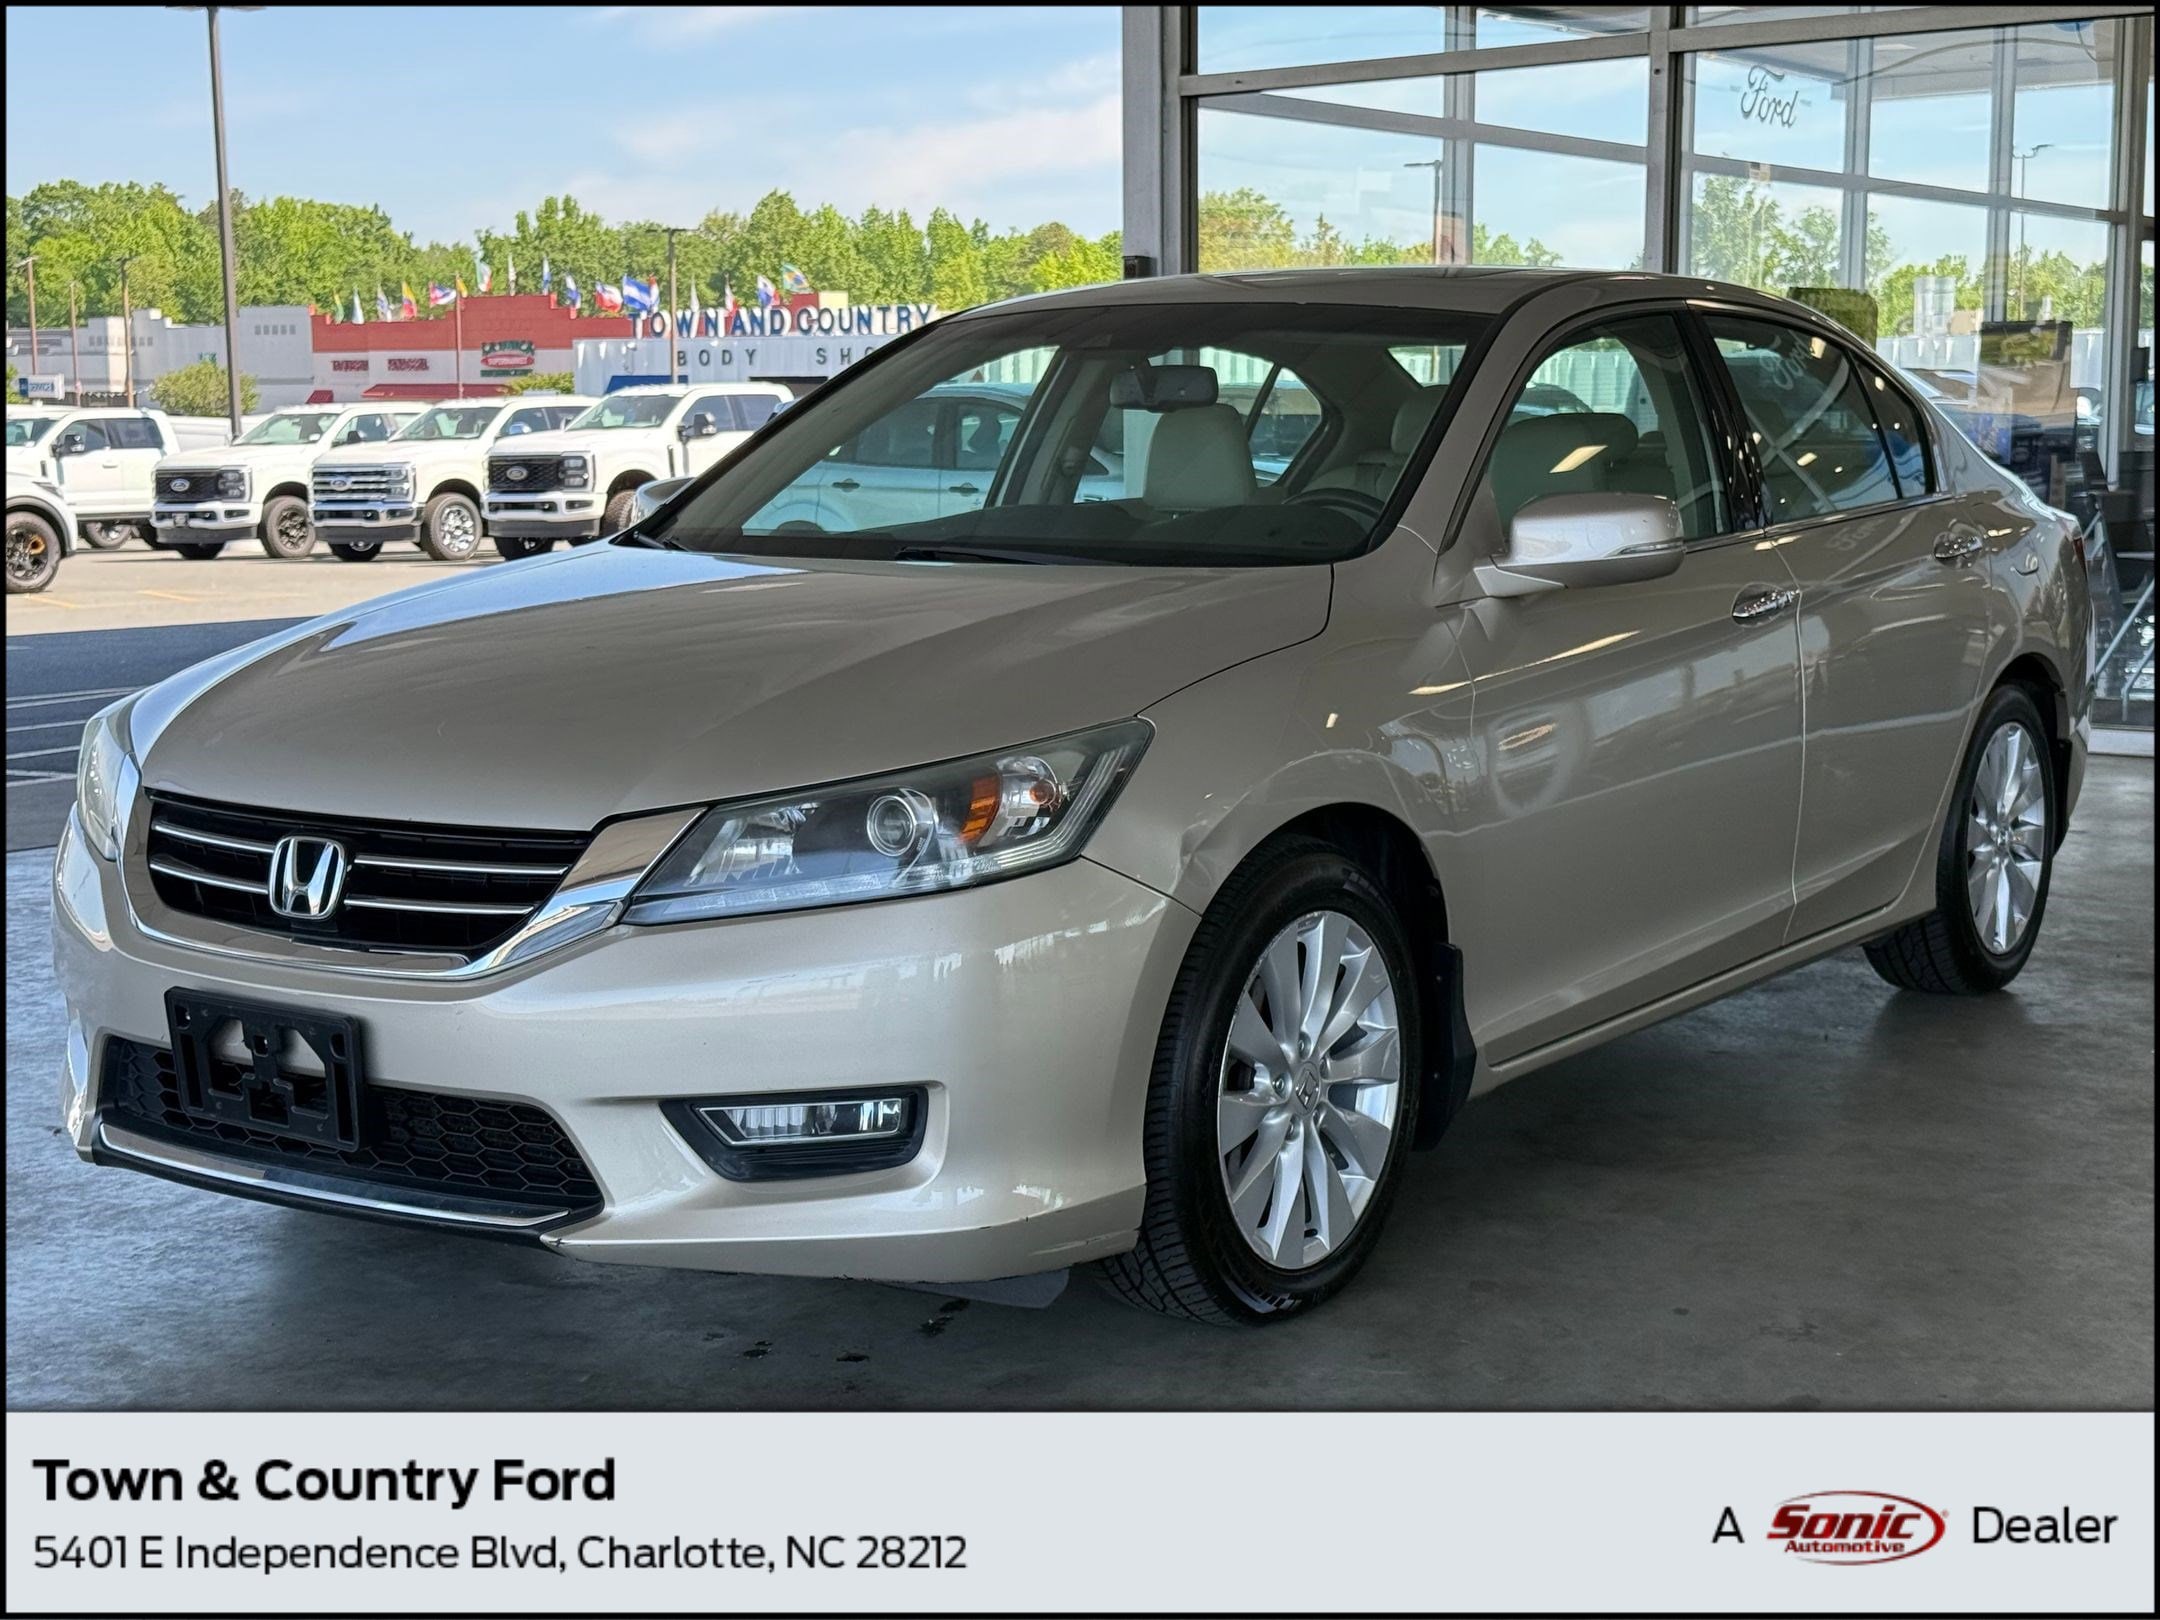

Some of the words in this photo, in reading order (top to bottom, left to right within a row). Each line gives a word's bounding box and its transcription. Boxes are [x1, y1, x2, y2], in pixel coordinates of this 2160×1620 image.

[1741, 65, 1798, 128] Ford
[628, 310, 724, 338] TOWN
[731, 308, 791, 336] AND
[797, 304, 933, 336] COUNTRY
[677, 348, 757, 366] BODY
